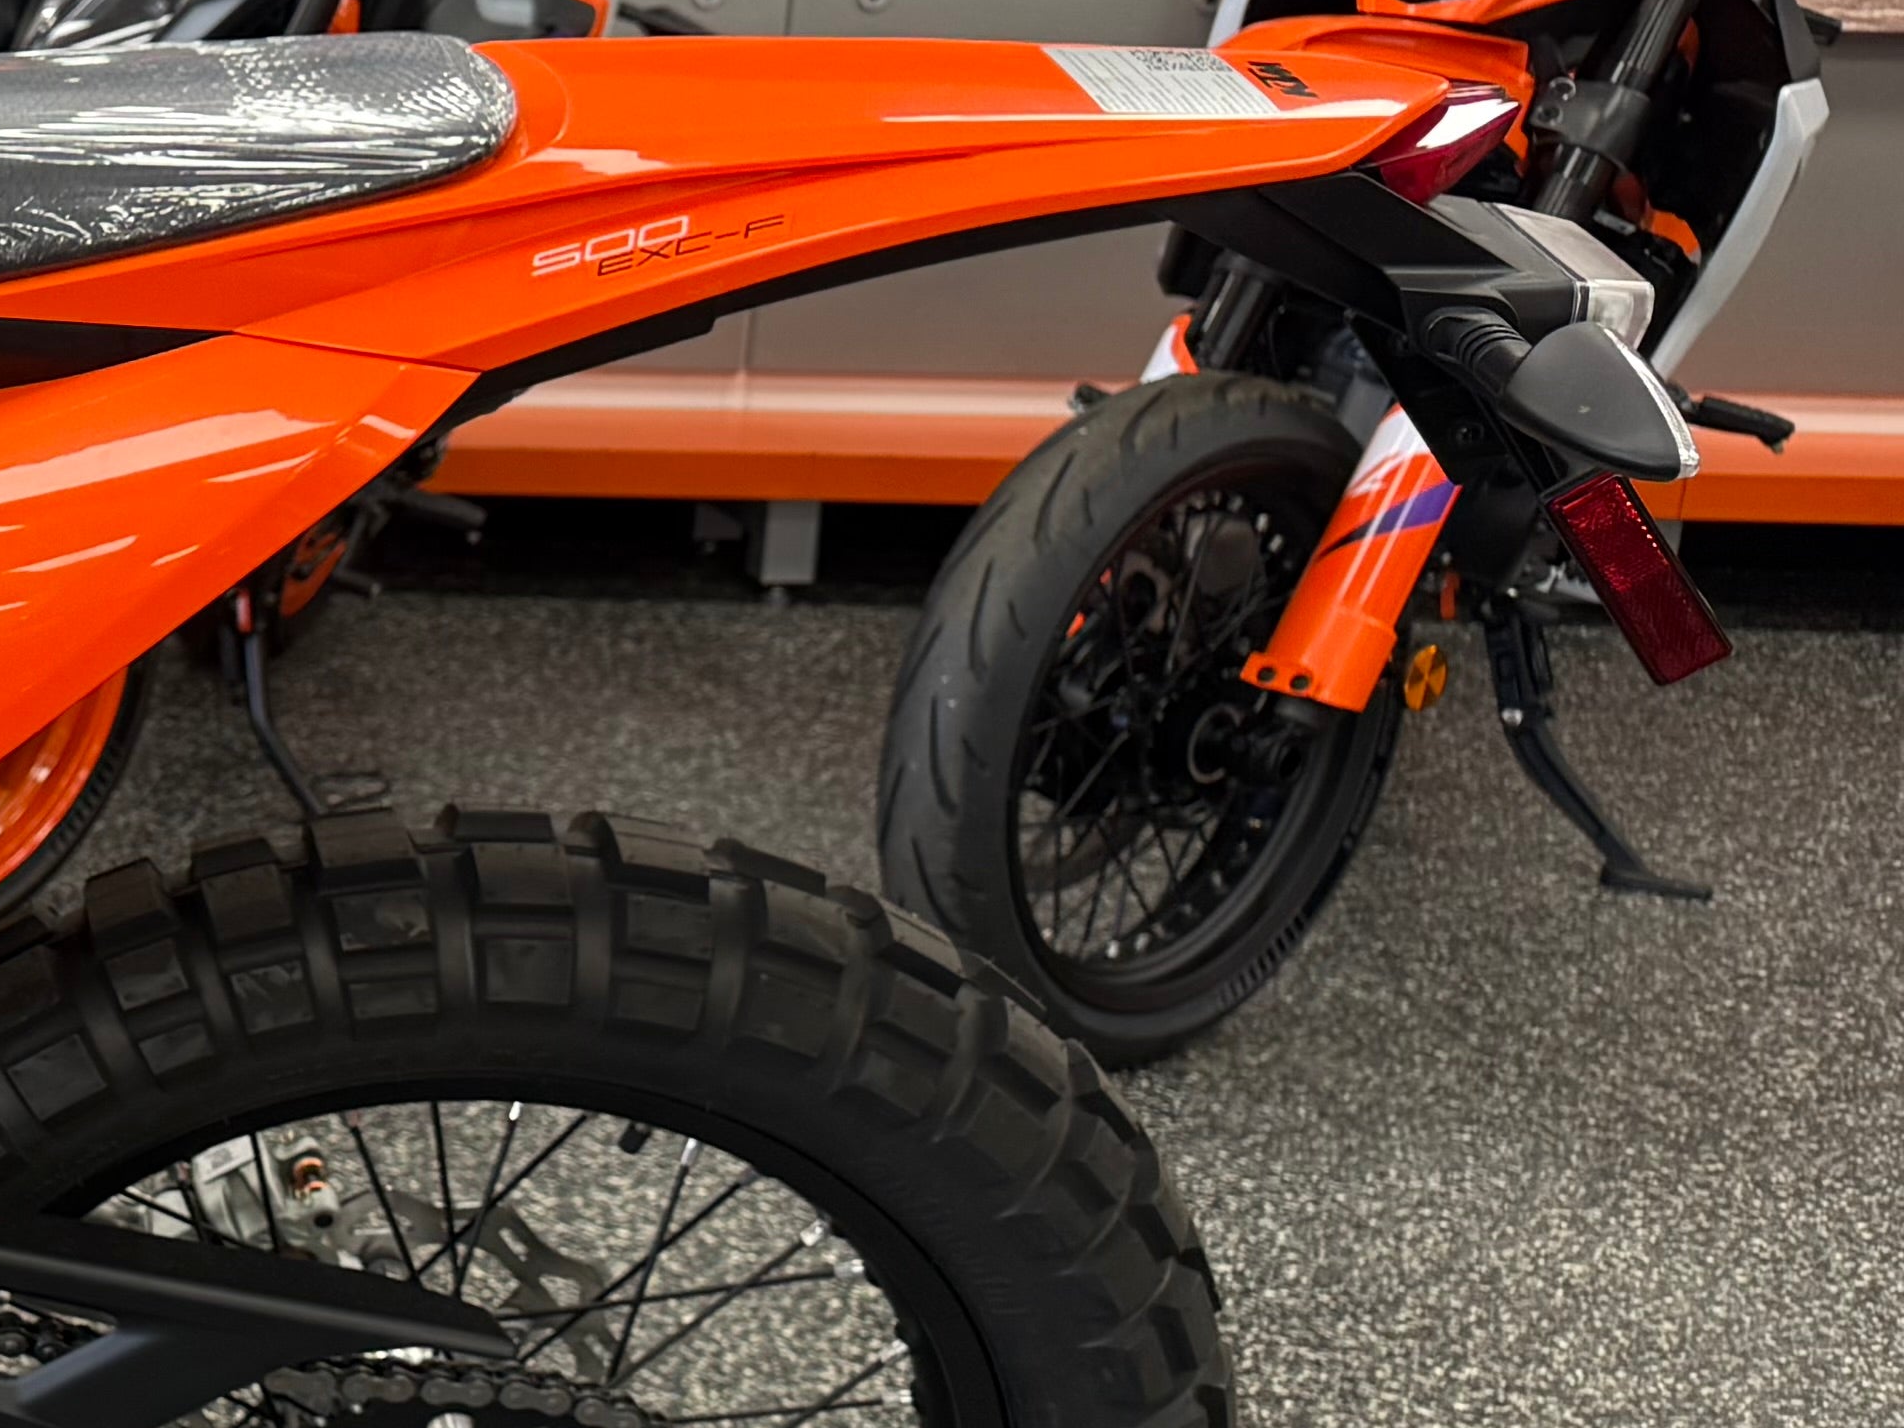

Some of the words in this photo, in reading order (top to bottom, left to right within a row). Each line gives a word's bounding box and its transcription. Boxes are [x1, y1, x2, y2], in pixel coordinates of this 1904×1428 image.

[1247, 60, 1320, 99] KTM
[531, 214, 691, 277] 500
[597, 214, 785, 277] EXC-F
